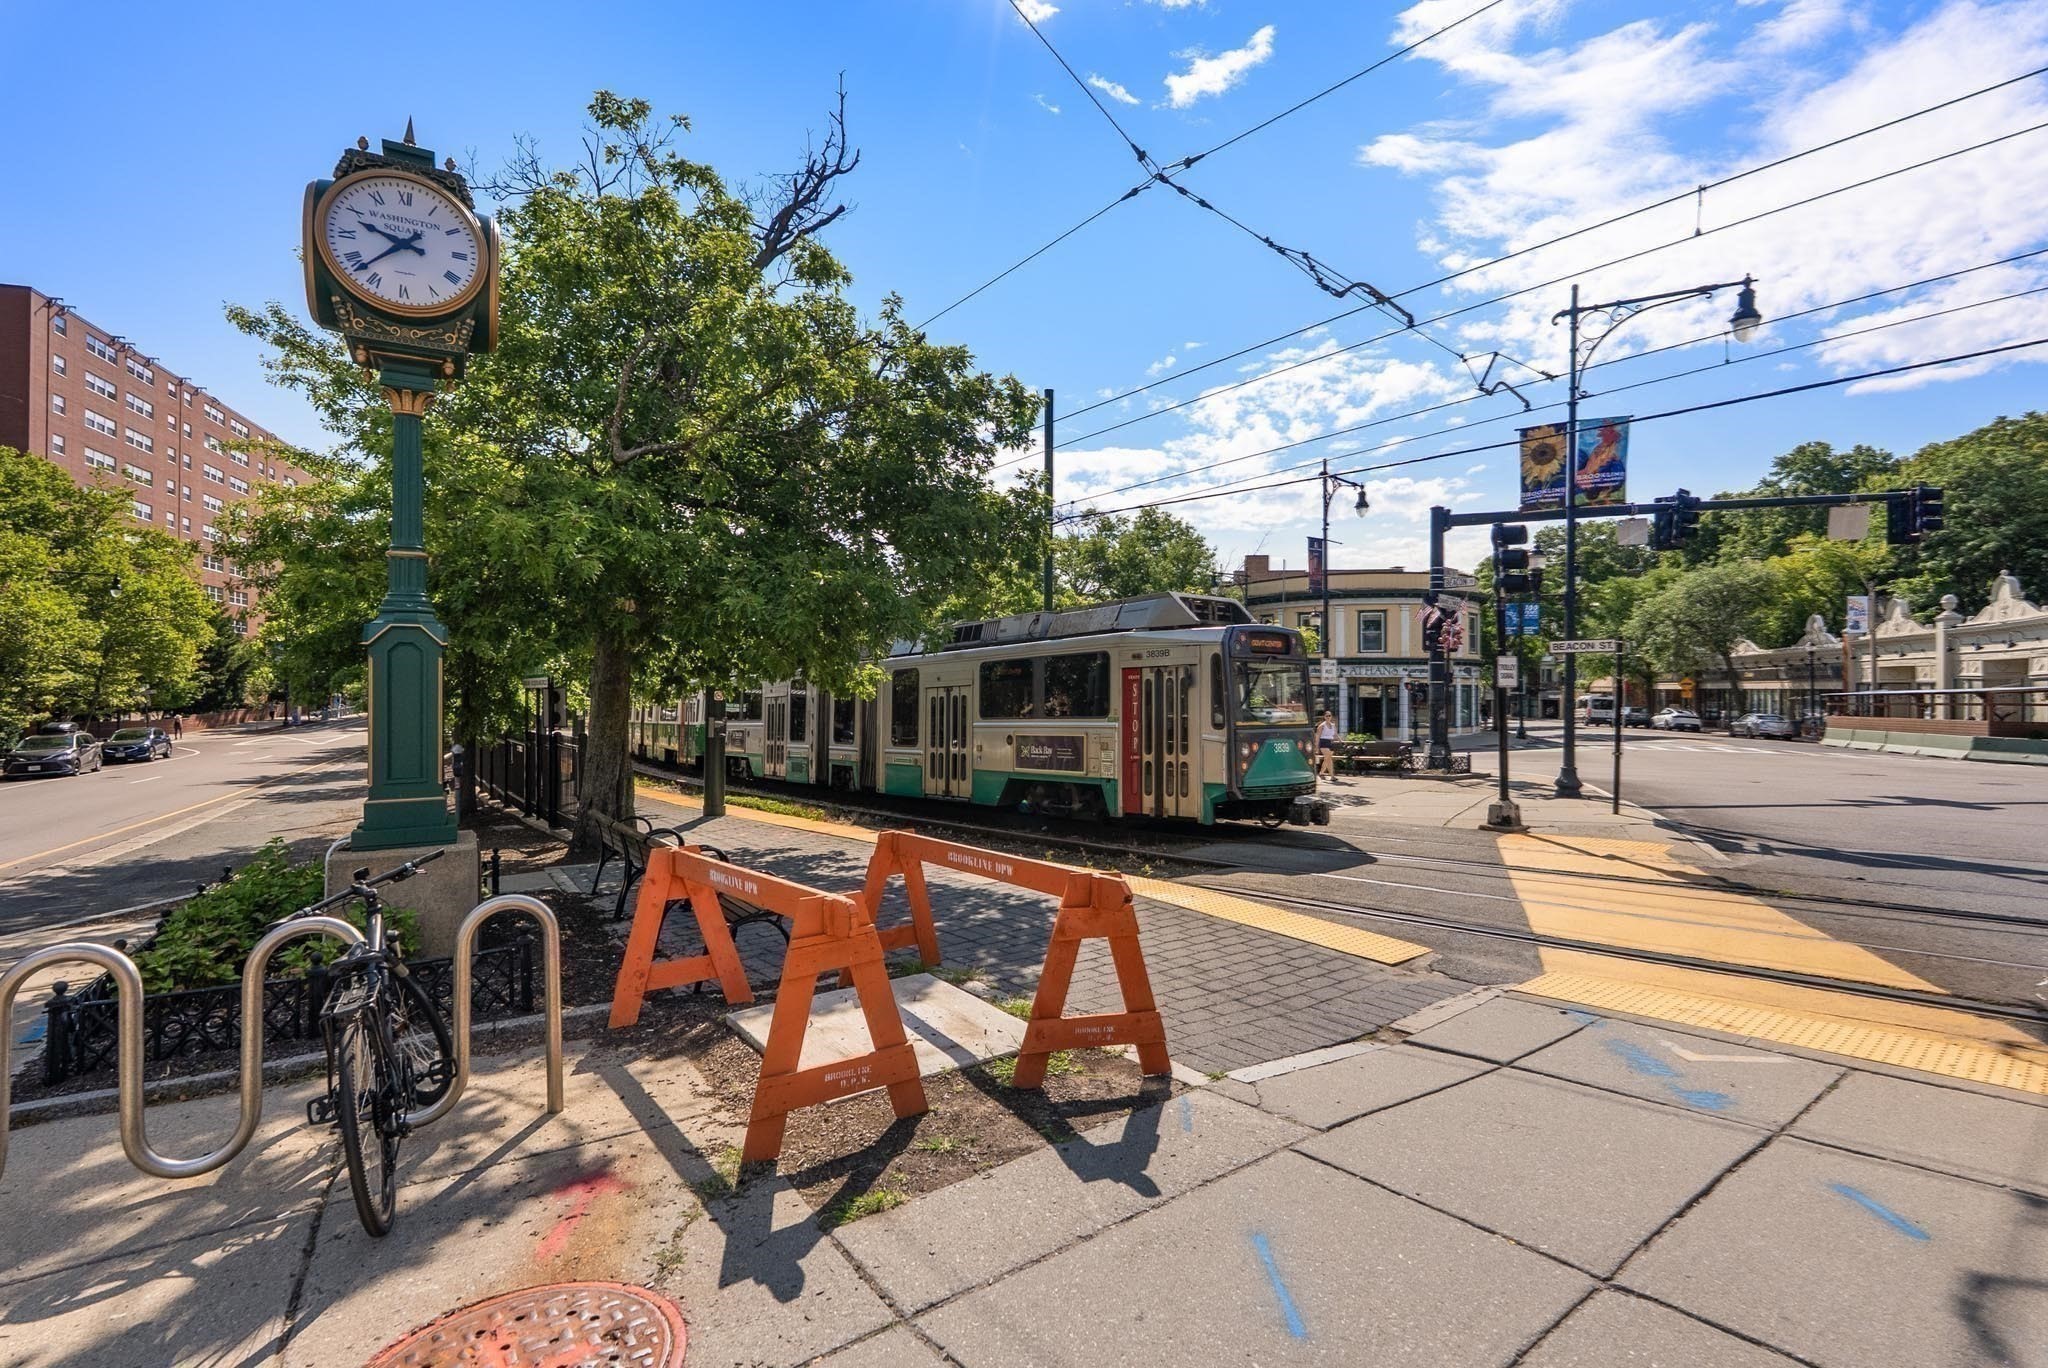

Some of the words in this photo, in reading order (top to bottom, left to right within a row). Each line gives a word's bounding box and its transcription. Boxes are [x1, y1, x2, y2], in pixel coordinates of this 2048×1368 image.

[368, 190, 385, 206] XI
[398, 190, 412, 207] XII
[346, 204, 364, 218] X
[369, 210, 440, 231] WASHINGTON
[338, 226, 356, 240] IX
[366, 272, 382, 288] VII
[399, 284, 410, 300] VI
[1577, 472, 1624, 480] BROOKLINE
[1520, 487, 1566, 498] BROOKLINE
[1446, 577, 1466, 587] BEACON
[1552, 642, 1594, 650] BEACON
[1599, 641, 1614, 650] ST.
[1146, 649, 1170, 658] 3839B
[1030, 746, 1042, 754] Back
[1044, 746, 1052, 755] Bay
[1273, 742, 1290, 752] 3839
[948, 852, 992, 872] BROOKLINE
[996, 862, 1013, 876] DPW
[710, 869, 742, 890] BROOKLINE
[744, 880, 758, 895] DPW
[824, 1065, 872, 1082] BROOKLINE
